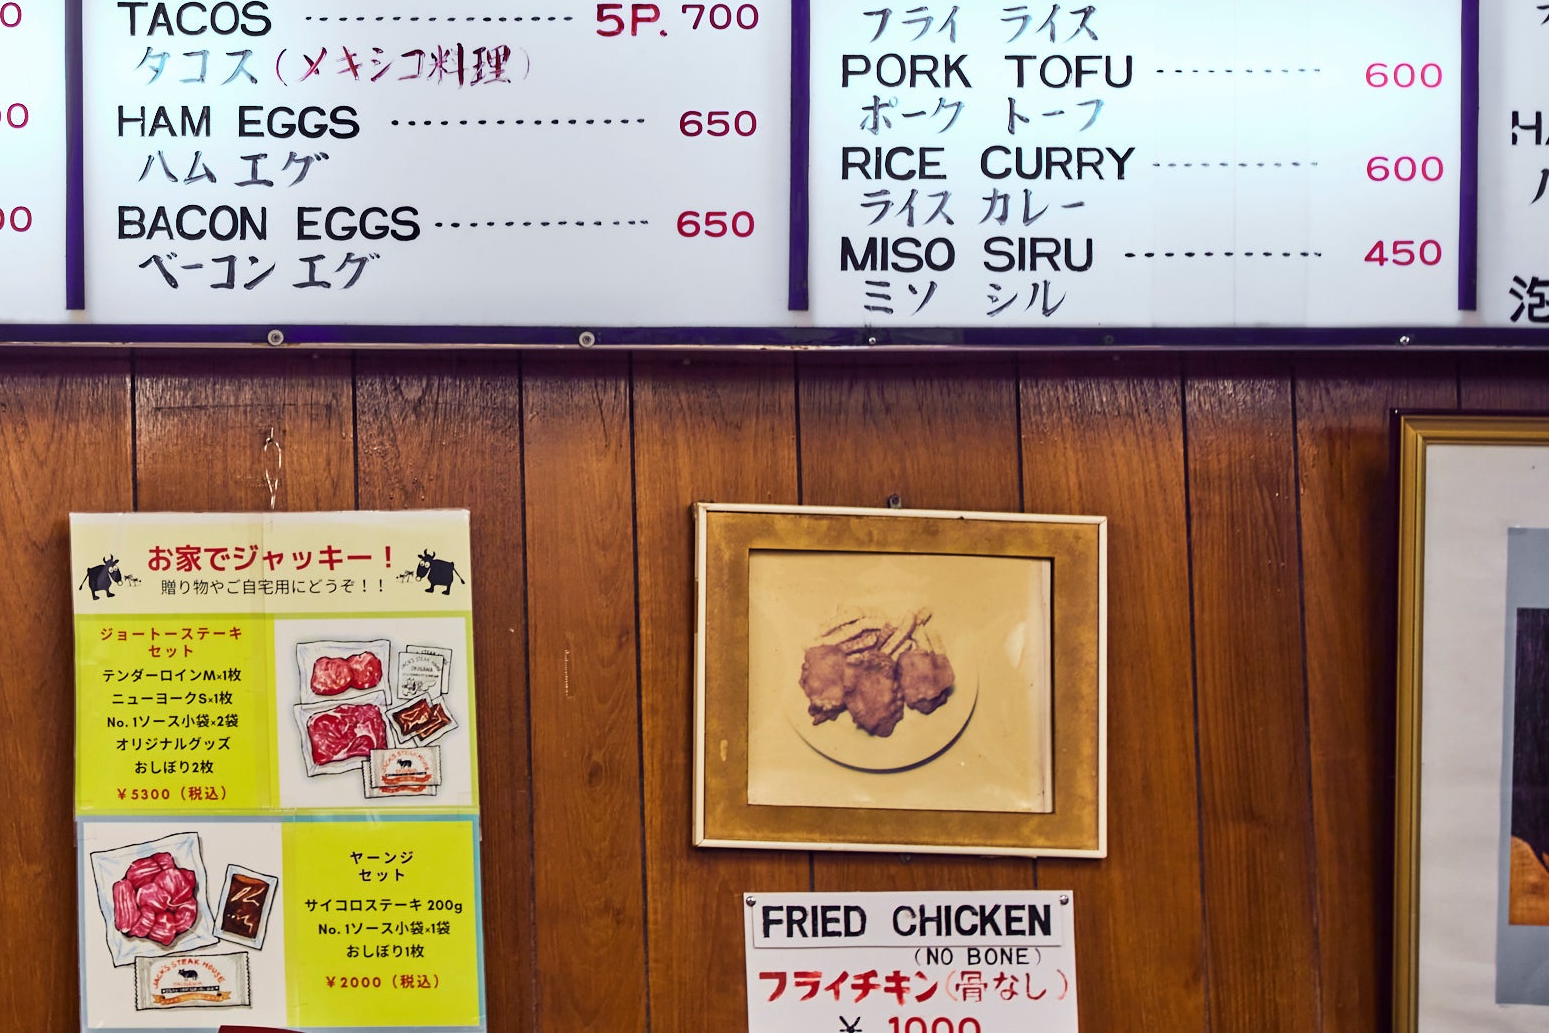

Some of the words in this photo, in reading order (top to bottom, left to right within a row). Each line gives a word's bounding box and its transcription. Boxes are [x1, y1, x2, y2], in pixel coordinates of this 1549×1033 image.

[116, 0, 273, 38] TACOS
[595, 2, 668, 38] 5P.
[681, 3, 759, 31] 700
[862, 5, 961, 44] フライ
[999, 3, 1099, 44] ライス
[136, 46, 259, 86] タコス
[841, 52, 973, 89] PORK
[1003, 54, 1133, 89] TOFU
[1365, 62, 1443, 89] 600
[117, 104, 211, 138] HAM
[238, 105, 361, 140] EGGS
[679, 109, 758, 138] 650
[859, 94, 965, 136] ポーク
[1007, 96, 1105, 136] トーフ
[137, 149, 218, 186] ハム
[233, 150, 330, 188] エグ
[841, 145, 948, 182] RICE
[980, 144, 1136, 181] CURRY
[1366, 155, 1444, 183] 600
[117, 204, 268, 242] BACON
[296, 205, 421, 242] EGGS
[676, 210, 755, 239] 650
[859, 188, 955, 228] ライス
[978, 187, 1085, 228] カレー
[138, 251, 277, 291] ベーコン
[291, 251, 381, 290] エグ
[840, 235, 956, 274] MISO
[983, 235, 1094, 273] SIRU
[1363, 238, 1443, 267] 450
[863, 279, 938, 316] ミソ
[986, 279, 1067, 318] シル
[147, 545, 393, 572] お家でジャッキー！
[101, 627, 242, 641] ジョートーステーキ
[148, 645, 193, 658] セット
[107, 717, 129, 728] No.
[116, 737, 230, 751] オリジナルグッズ
[135, 760, 214, 774] おしぼり2枚
[351, 851, 413, 865] ヤーンジ
[359, 868, 404, 881] セット
[305, 898, 421, 912] サイコロステーキ
[428, 900, 462, 913] 200g
[762, 905, 867, 938] FRIED
[892, 904, 1051, 937] CHICKEN
[319, 923, 341, 935] No.
[347, 944, 424, 958] おしぼり1枚
